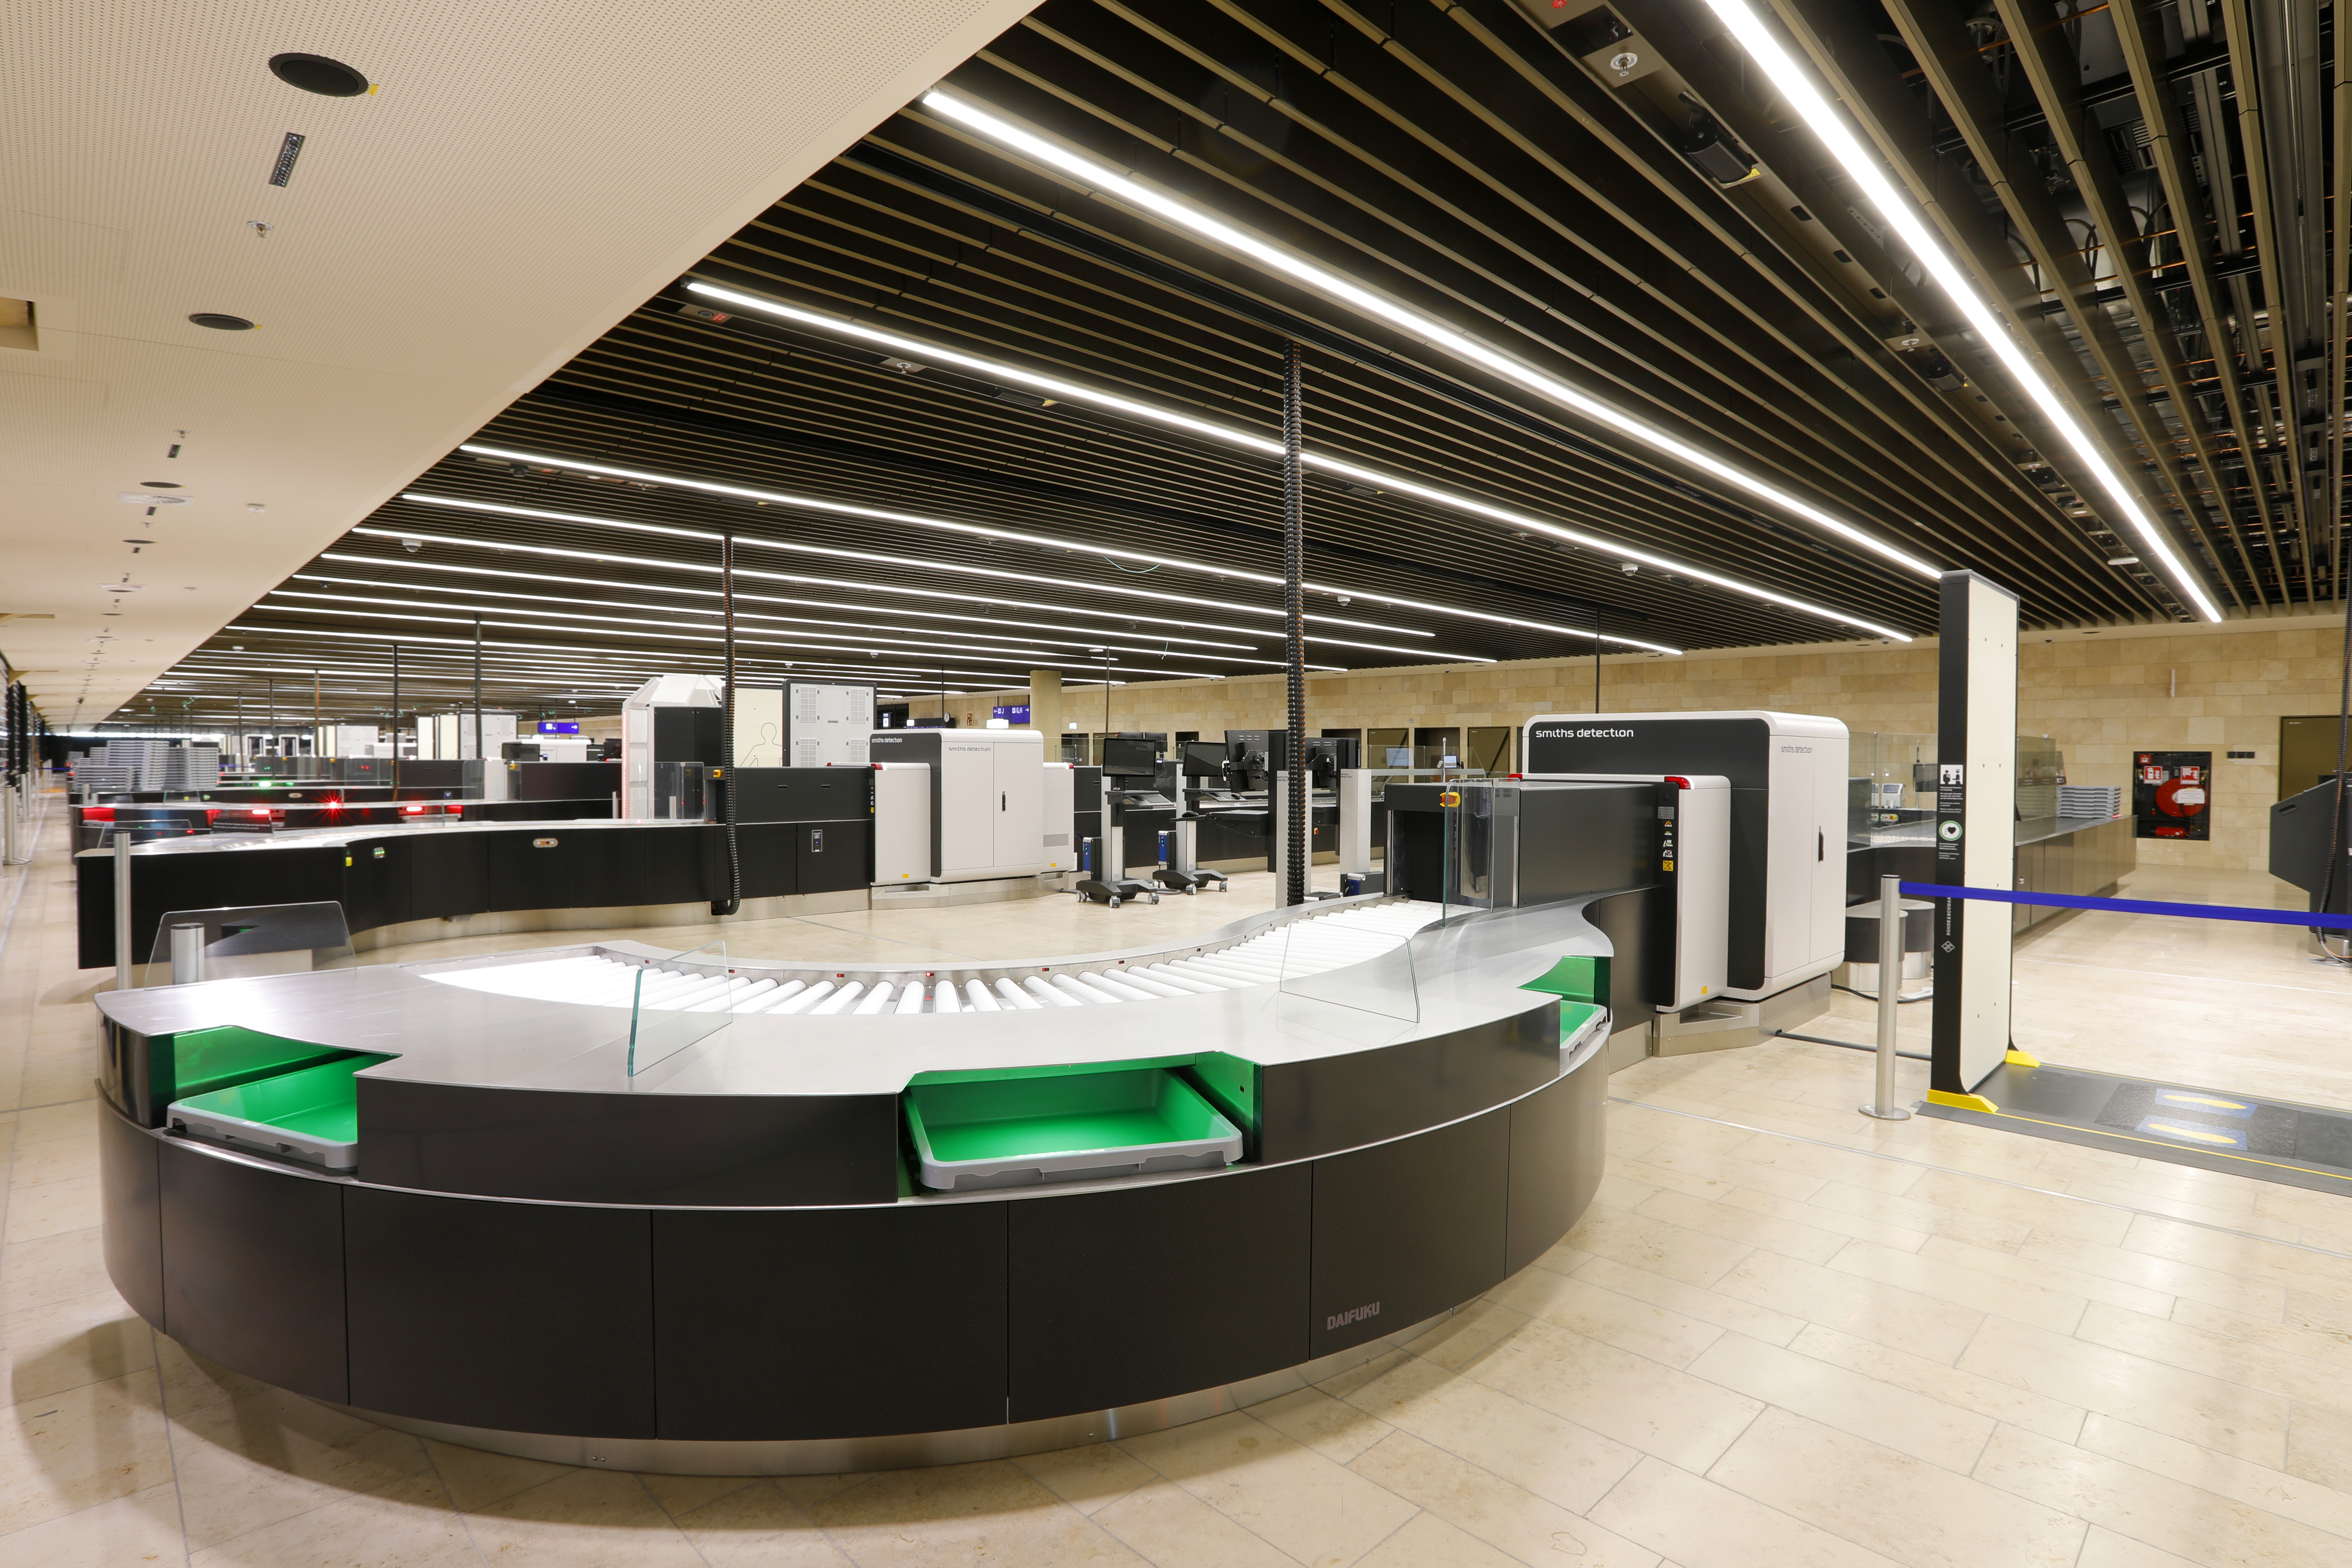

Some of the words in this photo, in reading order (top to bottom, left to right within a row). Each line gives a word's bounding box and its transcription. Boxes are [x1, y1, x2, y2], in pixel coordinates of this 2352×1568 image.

[1536, 729, 1574, 738] smiths
[1577, 728, 1634, 737] detection
[1327, 1301, 1380, 1330] DAIFUKU
